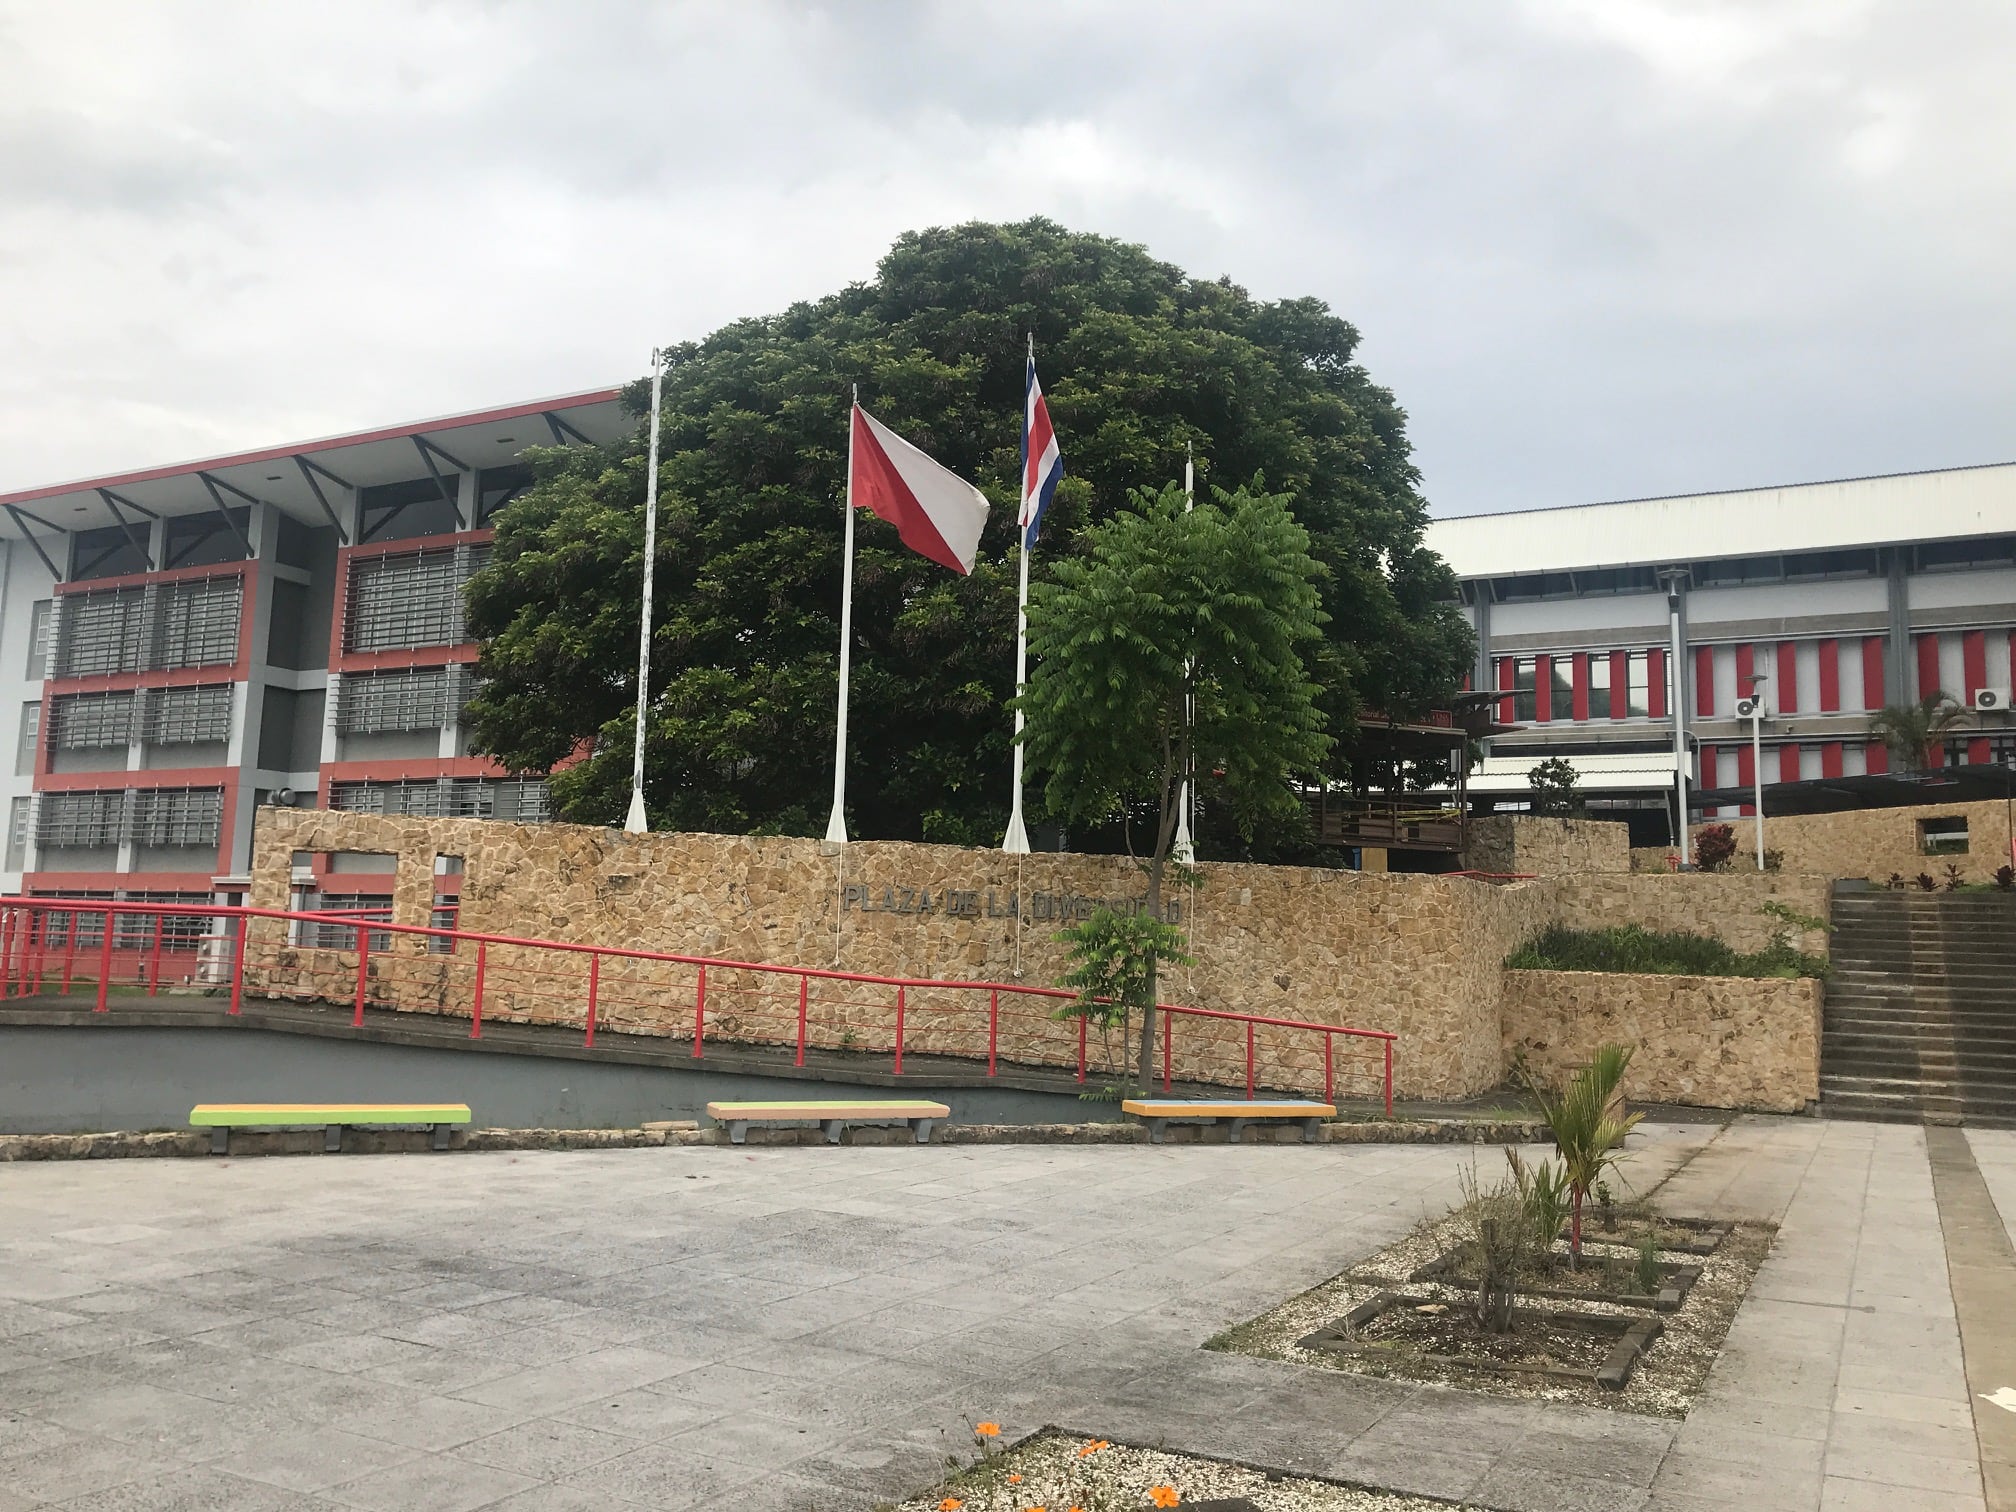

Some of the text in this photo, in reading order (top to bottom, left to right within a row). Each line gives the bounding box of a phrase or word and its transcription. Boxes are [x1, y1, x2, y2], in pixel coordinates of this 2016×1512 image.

[843, 884, 1182, 924] PLAZA DE LA DIVESID
